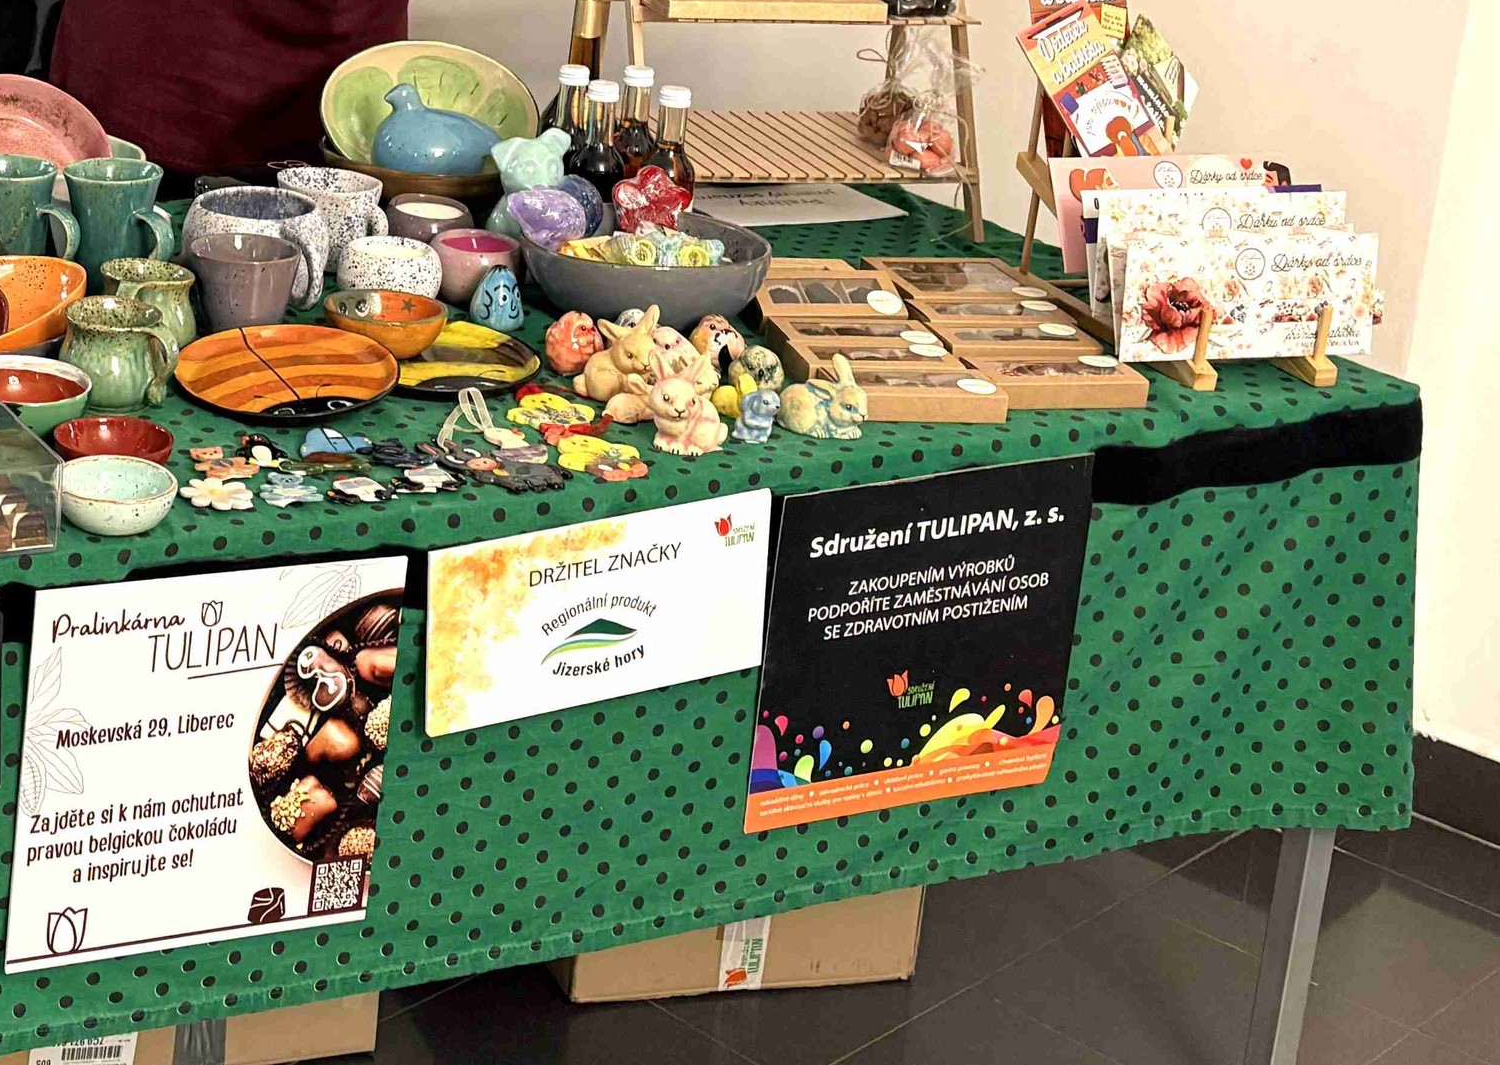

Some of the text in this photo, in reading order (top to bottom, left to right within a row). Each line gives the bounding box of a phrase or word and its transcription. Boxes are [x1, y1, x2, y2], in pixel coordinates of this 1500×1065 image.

[1190, 169, 1263, 184] Dárky od srdce
[1281, 215, 1295, 227] od
[1298, 215, 1326, 227] srdce
[1271, 252, 1362, 272] Dárky od srdce
[809, 507, 1065, 559] Sdružení TULIPAN, z. s.
[529, 541, 682, 588] DRŽITEL ZNAČKY
[848, 554, 1016, 596] ZAKOUPENÍM VÝROBKŮ
[541, 592, 657, 637] Regionální produkt
[808, 571, 1050, 623] PODPOŘÍTE ZAMĚSTNÁVÁNÍ OSOB
[823, 594, 1029, 641] SE ZDRAVOTNÍM POSTIŽENÍM
[52, 607, 185, 643] Pralinkárna
[148, 623, 283, 673] TULIPAN
[552, 644, 645, 677] Jizerské hory
[898, 691, 934, 709] TULIPAN
[56, 712, 235, 750] Moskevská 29, Liberec
[29, 788, 244, 835] Zajděte si k nám ochutnat
[27, 818, 237, 867] pravou belgickou čokoládu
[72, 850, 194, 884] a inspirujte se!
